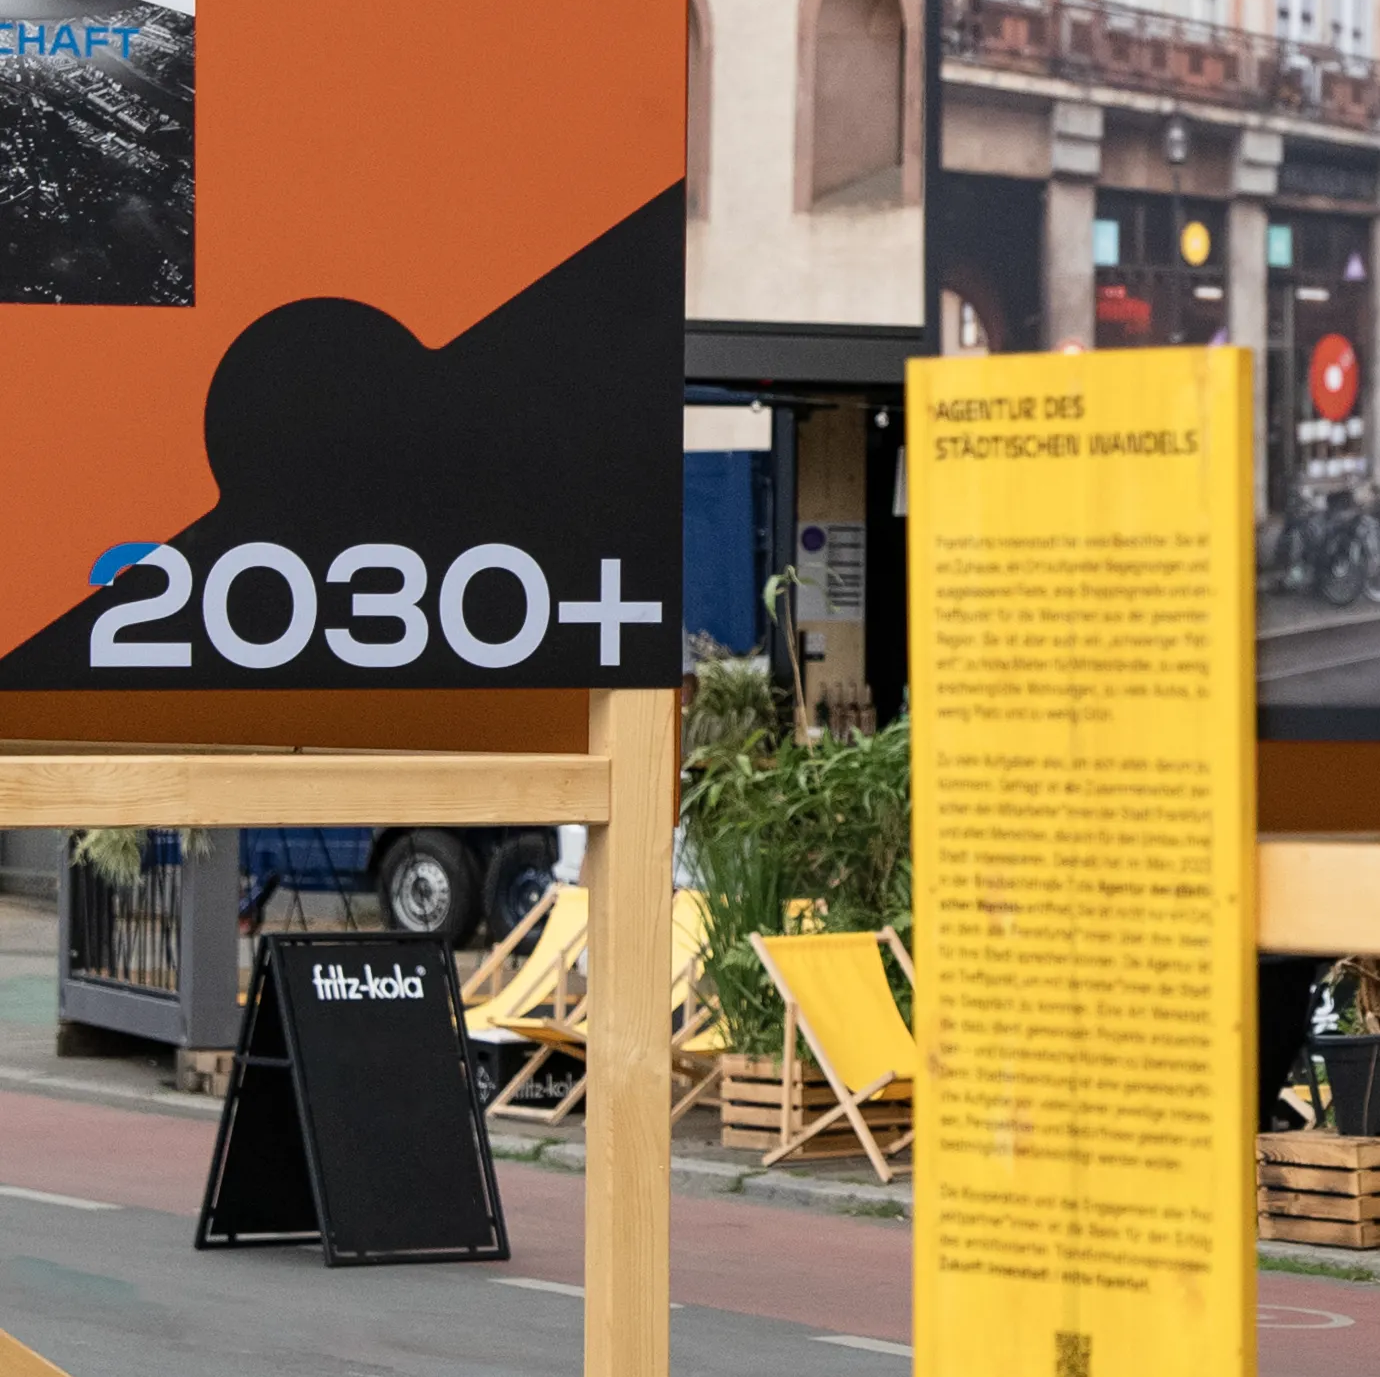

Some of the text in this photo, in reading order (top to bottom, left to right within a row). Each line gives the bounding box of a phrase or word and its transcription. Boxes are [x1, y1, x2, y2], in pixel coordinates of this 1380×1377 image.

[935, 394, 1085, 423] AGENTUR DES
[934, 428, 1199, 461] STÄDTISCHEN WANDELS
[89, 541, 663, 669] 2030+
[312, 963, 425, 1000] fritz-kola
